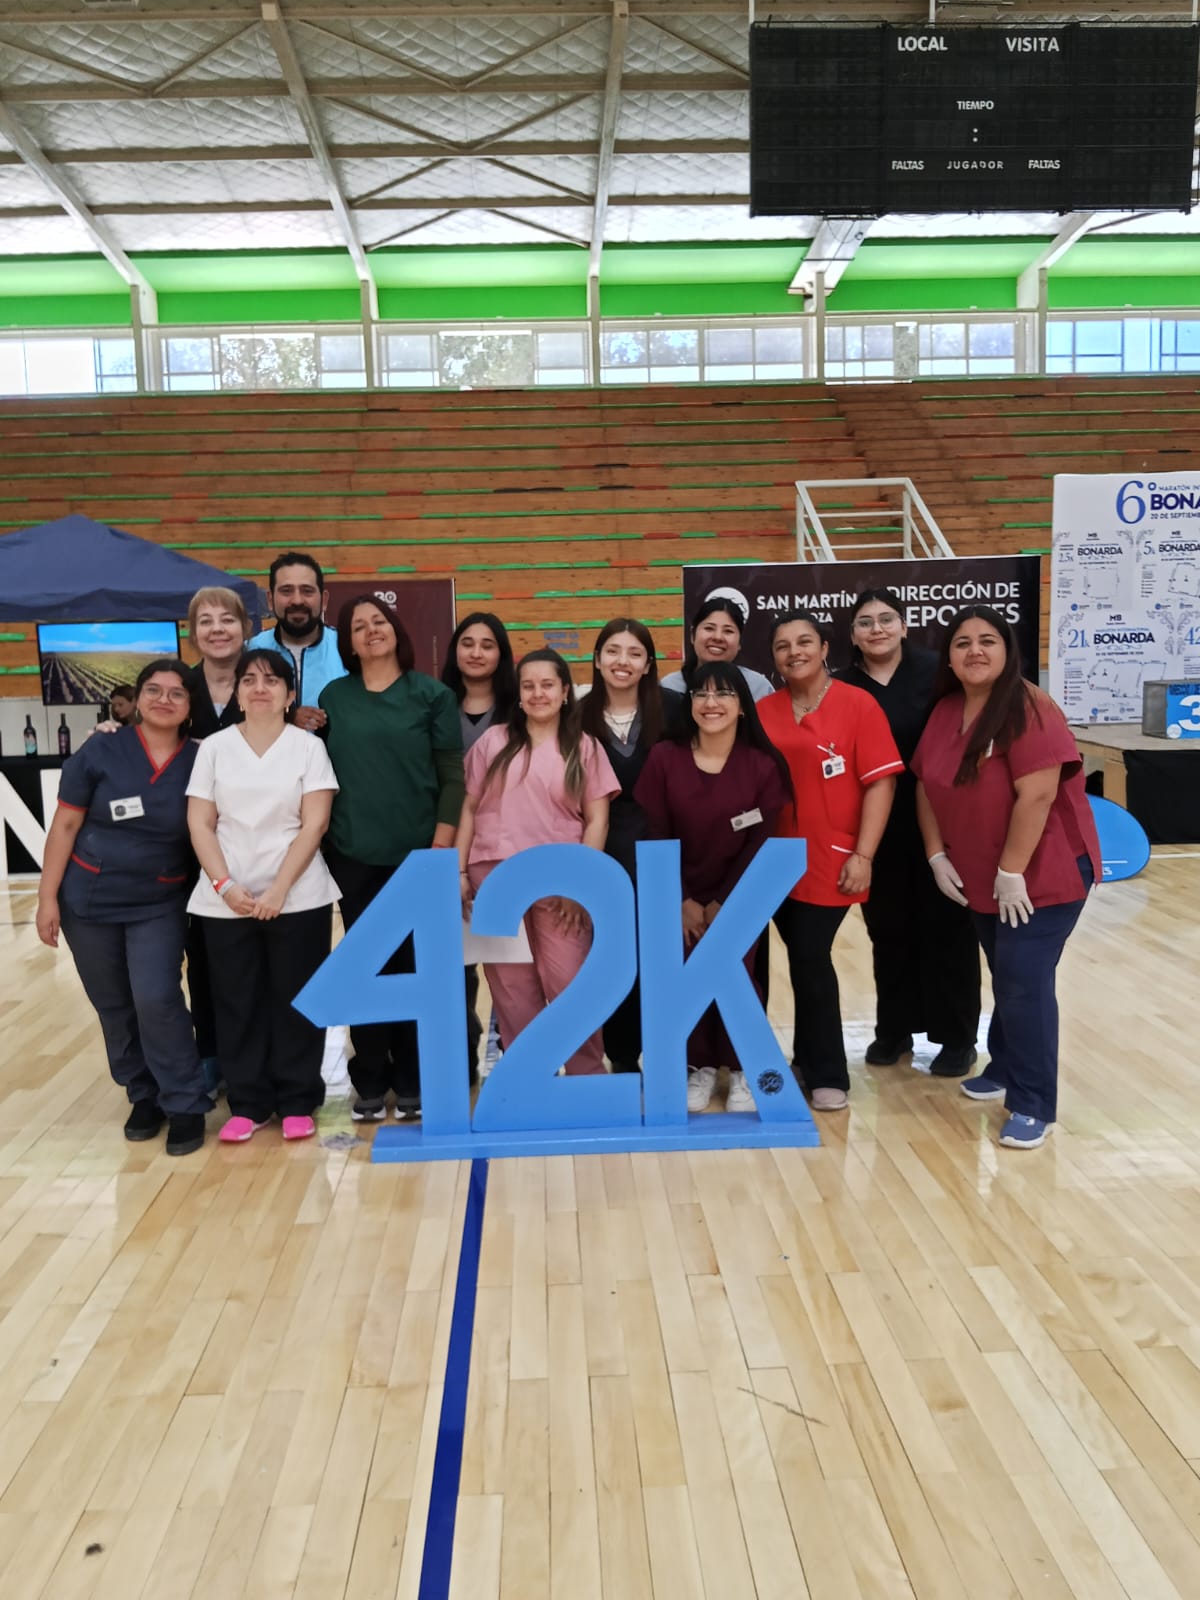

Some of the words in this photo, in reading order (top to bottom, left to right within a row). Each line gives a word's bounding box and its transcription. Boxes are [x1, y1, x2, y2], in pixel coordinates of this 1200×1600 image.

[897, 36, 948, 52] LOCAL
[1005, 36, 1060, 53] VISITA
[956, 100, 994, 110] TIEMPO
[891, 160, 925, 171] FALTAS
[946, 160, 1004, 170] JUGADOR
[1028, 160, 1061, 170] FALTAS
[1077, 547, 1123, 556] BONARDA
[995, 582, 1020, 599] DE
[756, 595, 789, 610] SAN
[794, 590, 857, 609] MARTÍN
[905, 602, 1020, 628] EPOS
[1093, 632, 1155, 645] BONARDA
[291, 837, 813, 1137] 42K
